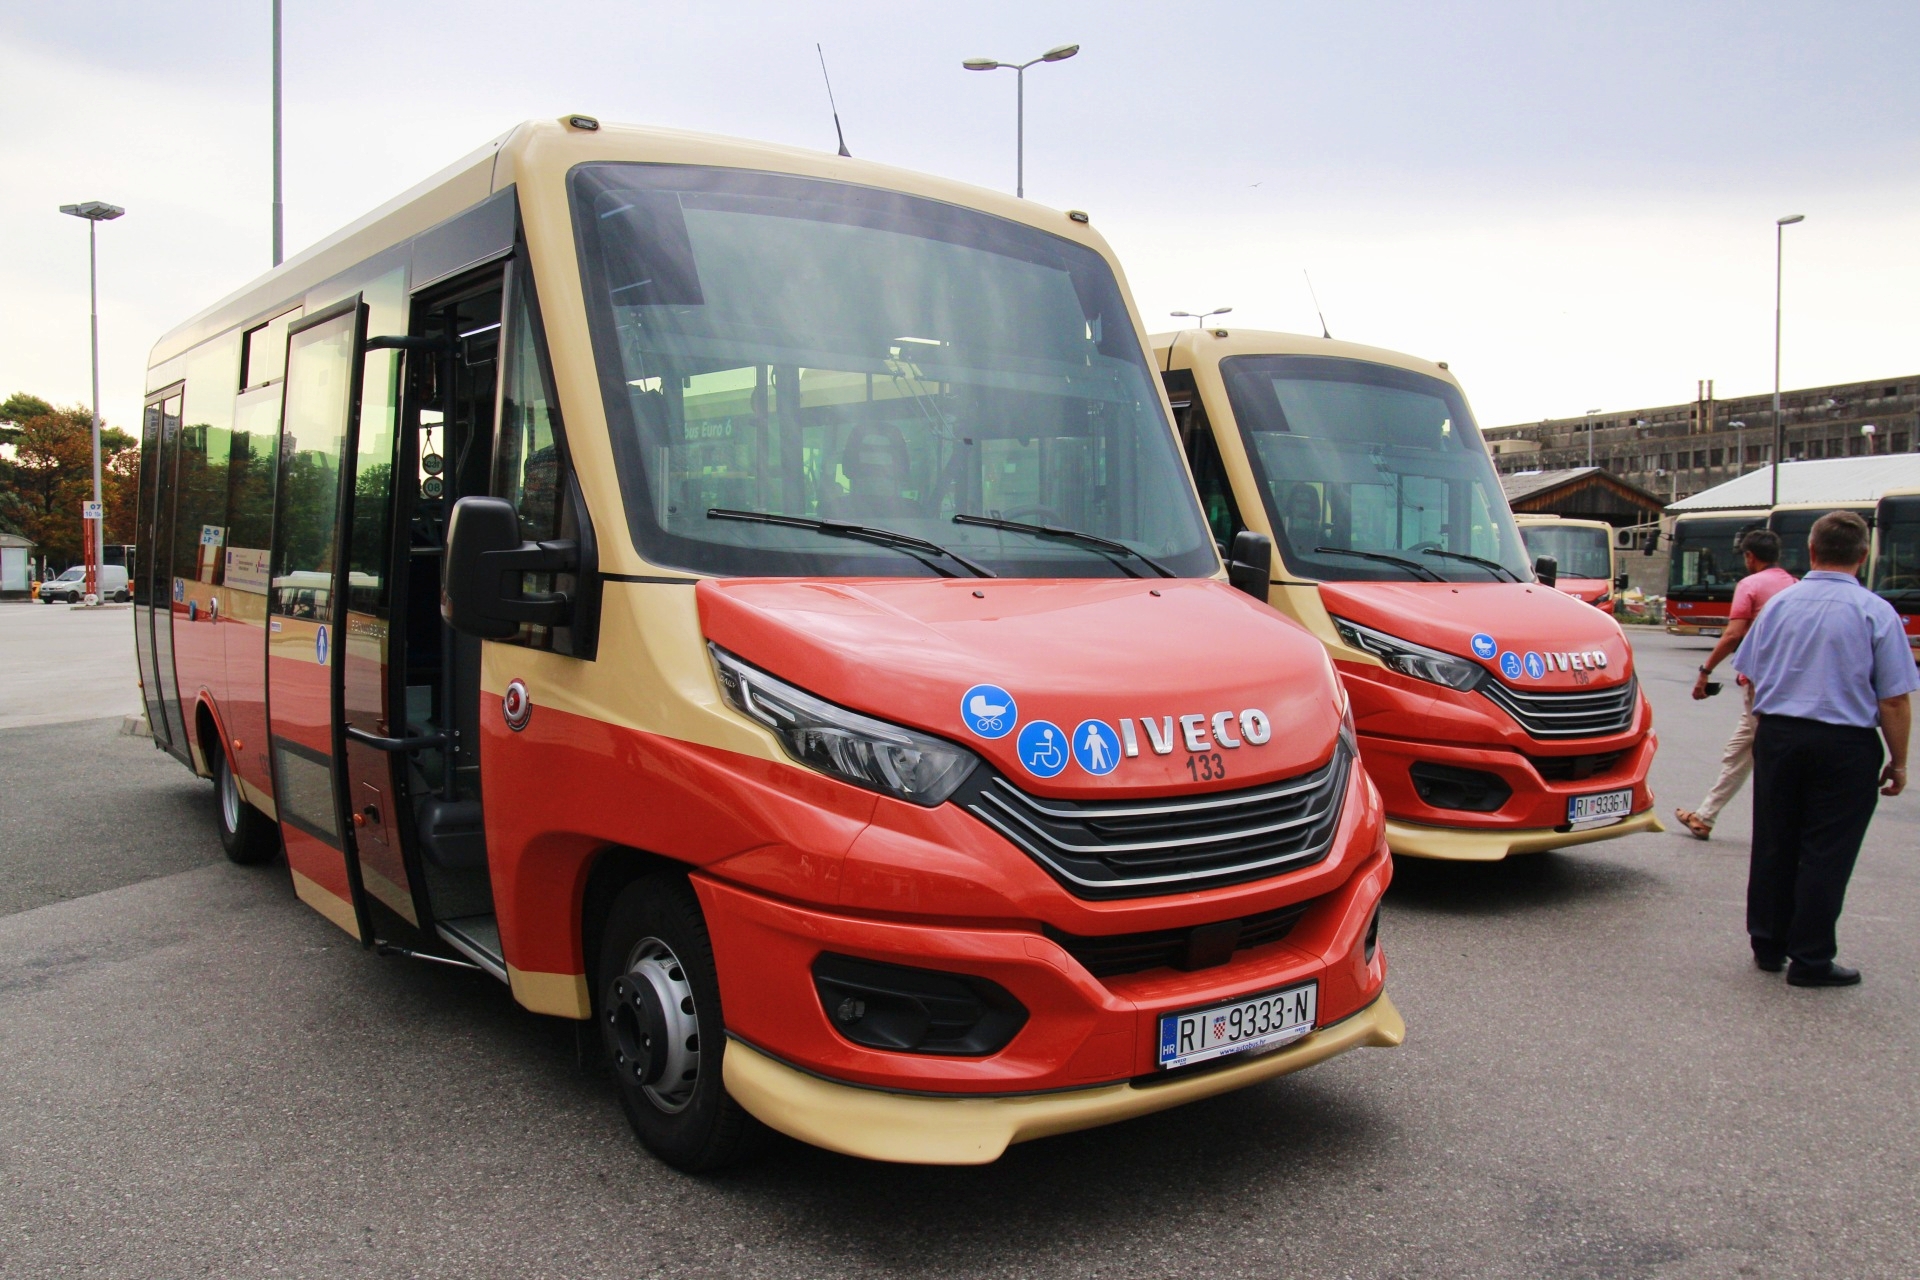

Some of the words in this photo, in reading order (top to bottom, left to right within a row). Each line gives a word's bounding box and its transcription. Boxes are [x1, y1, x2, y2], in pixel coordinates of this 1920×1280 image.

[701, 421, 722, 438] Euro
[725, 419, 731, 436] 6
[1543, 650, 1608, 673] IVECO
[1573, 671, 1590, 685] 136
[1118, 708, 1272, 758] IVECO
[1186, 753, 1226, 782] 133
[1576, 799, 1588, 817] RI
[1595, 793, 1630, 815] 9336-N
[1180, 1015, 1207, 1054] RI
[1228, 990, 1308, 1042] 9333-N
[1162, 1044, 1176, 1056] HR
[1219, 1039, 1267, 1056] www.autobus.hr
